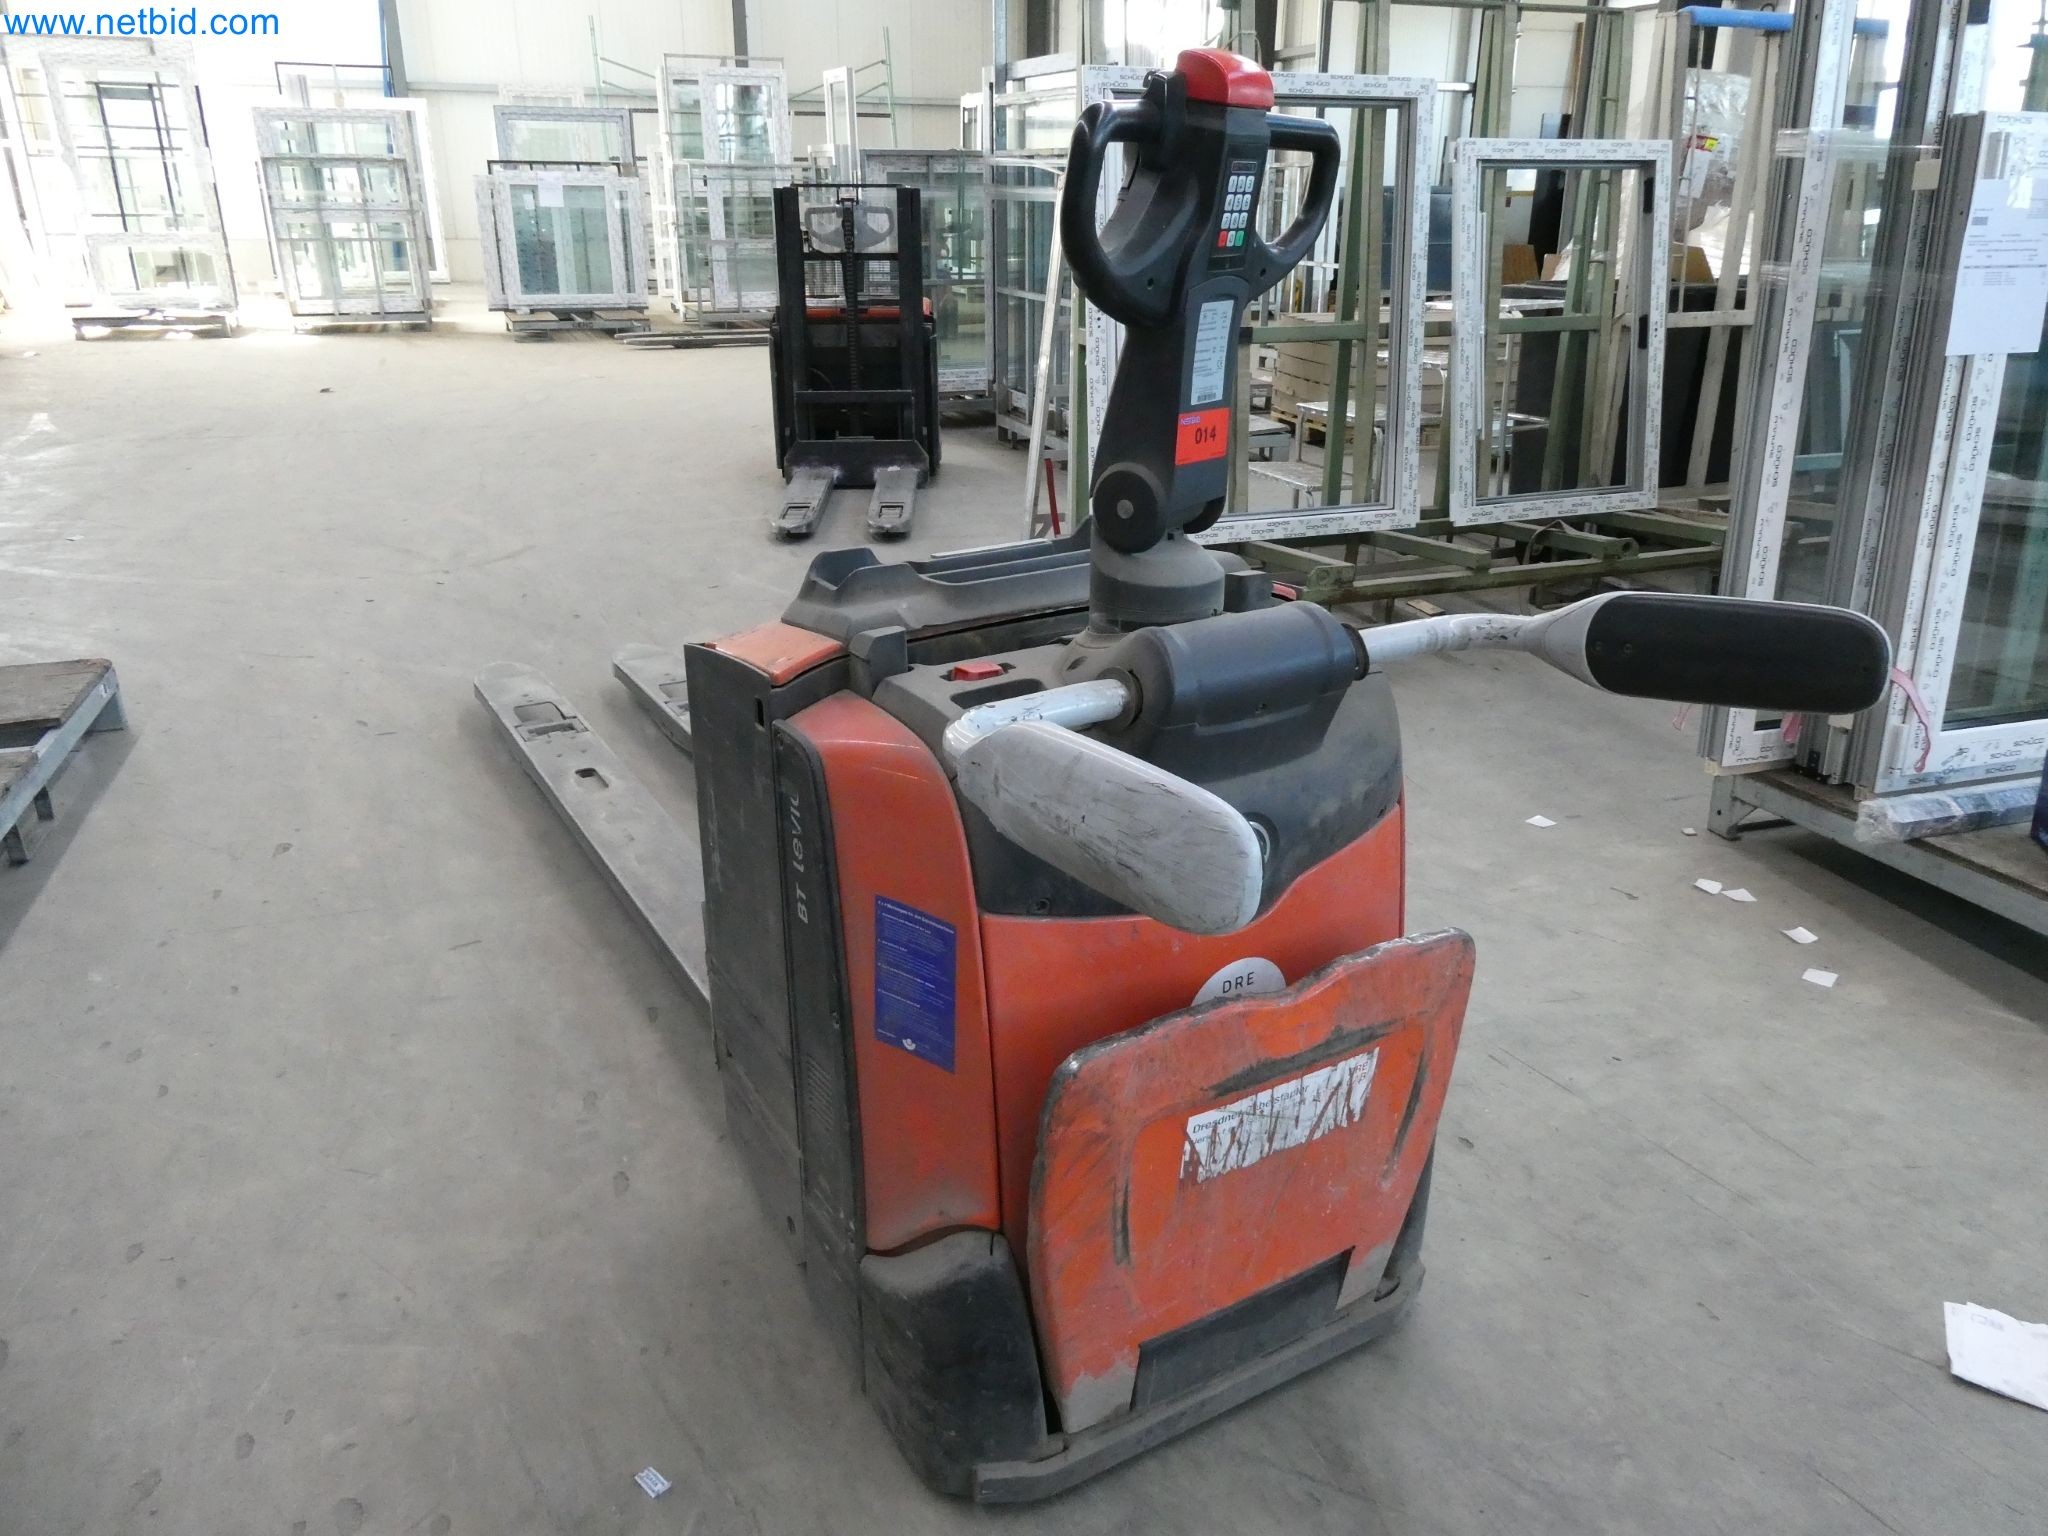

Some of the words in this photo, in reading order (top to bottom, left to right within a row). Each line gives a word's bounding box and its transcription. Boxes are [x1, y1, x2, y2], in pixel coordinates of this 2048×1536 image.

[1195, 426, 1216, 445] 014
[795, 881, 808, 924] BT
[1222, 971, 1255, 994] DRE
